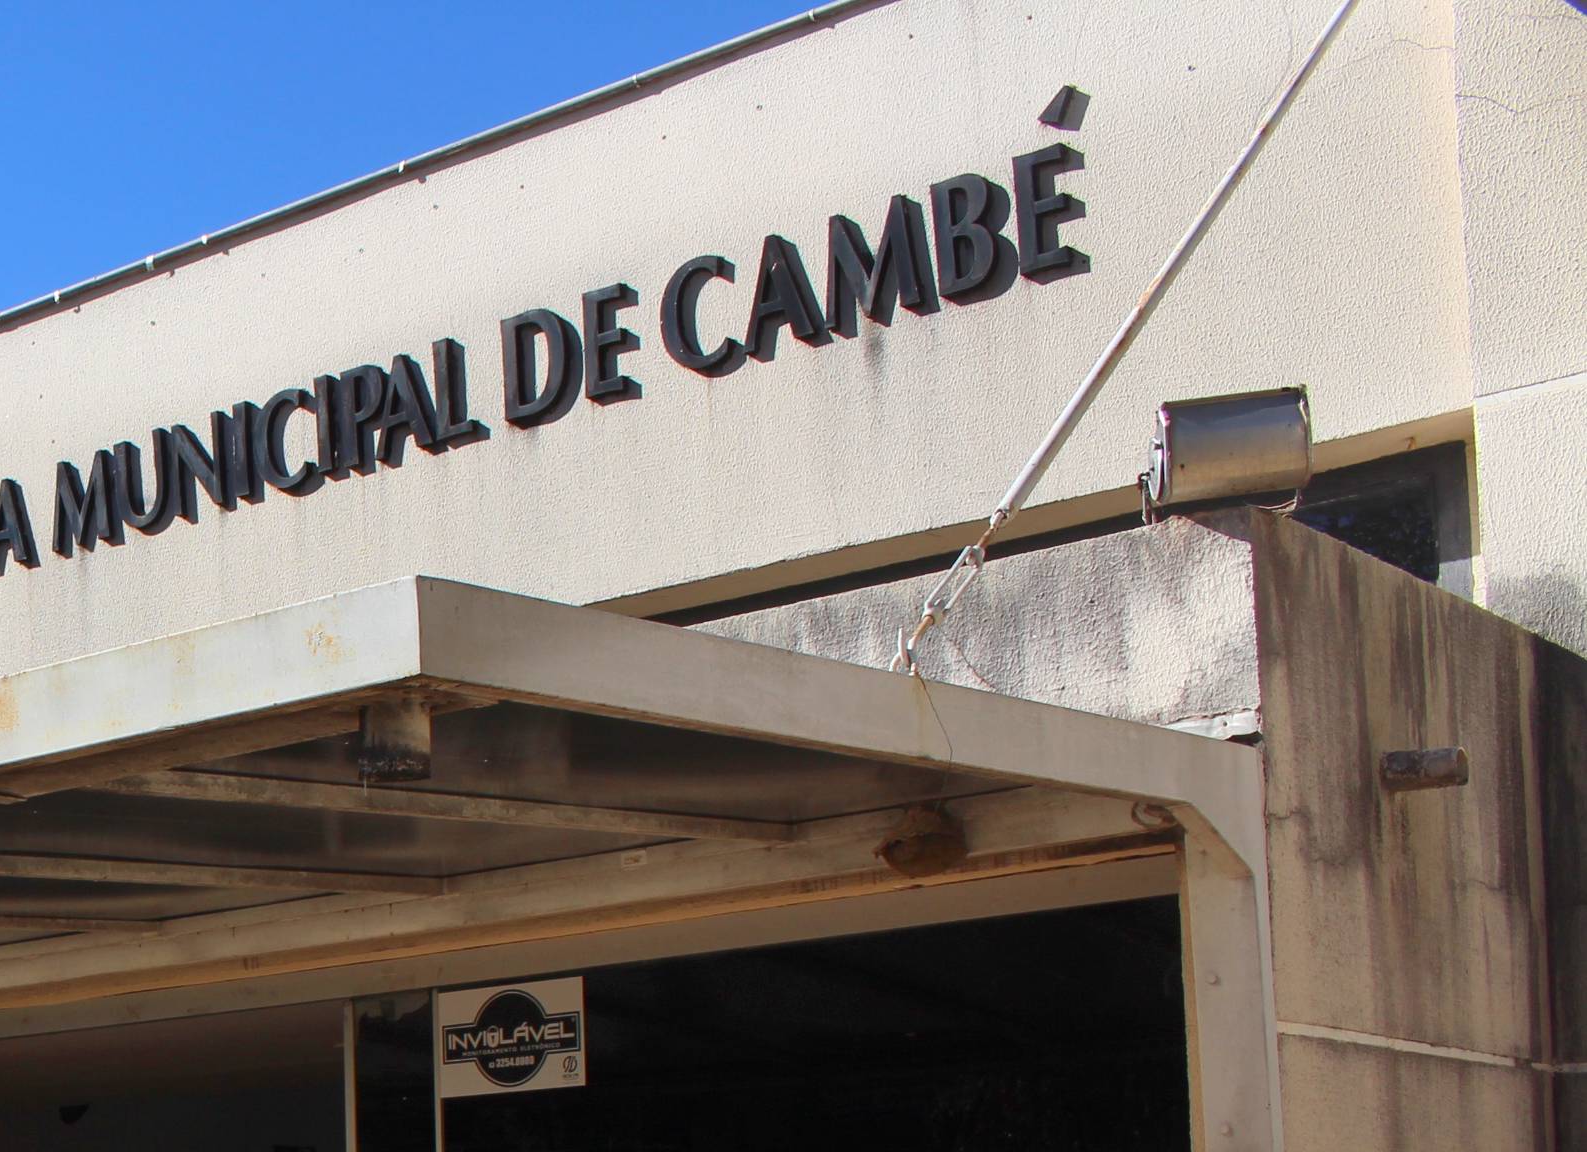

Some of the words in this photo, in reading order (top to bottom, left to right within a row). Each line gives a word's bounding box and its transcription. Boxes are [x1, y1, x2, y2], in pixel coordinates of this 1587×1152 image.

[52, 337, 491, 559] MUNICIPAL
[499, 282, 642, 429] DE
[660, 85, 1091, 377] CAMBÉ
[448, 1021, 575, 1051] INVIOLÁVEL
